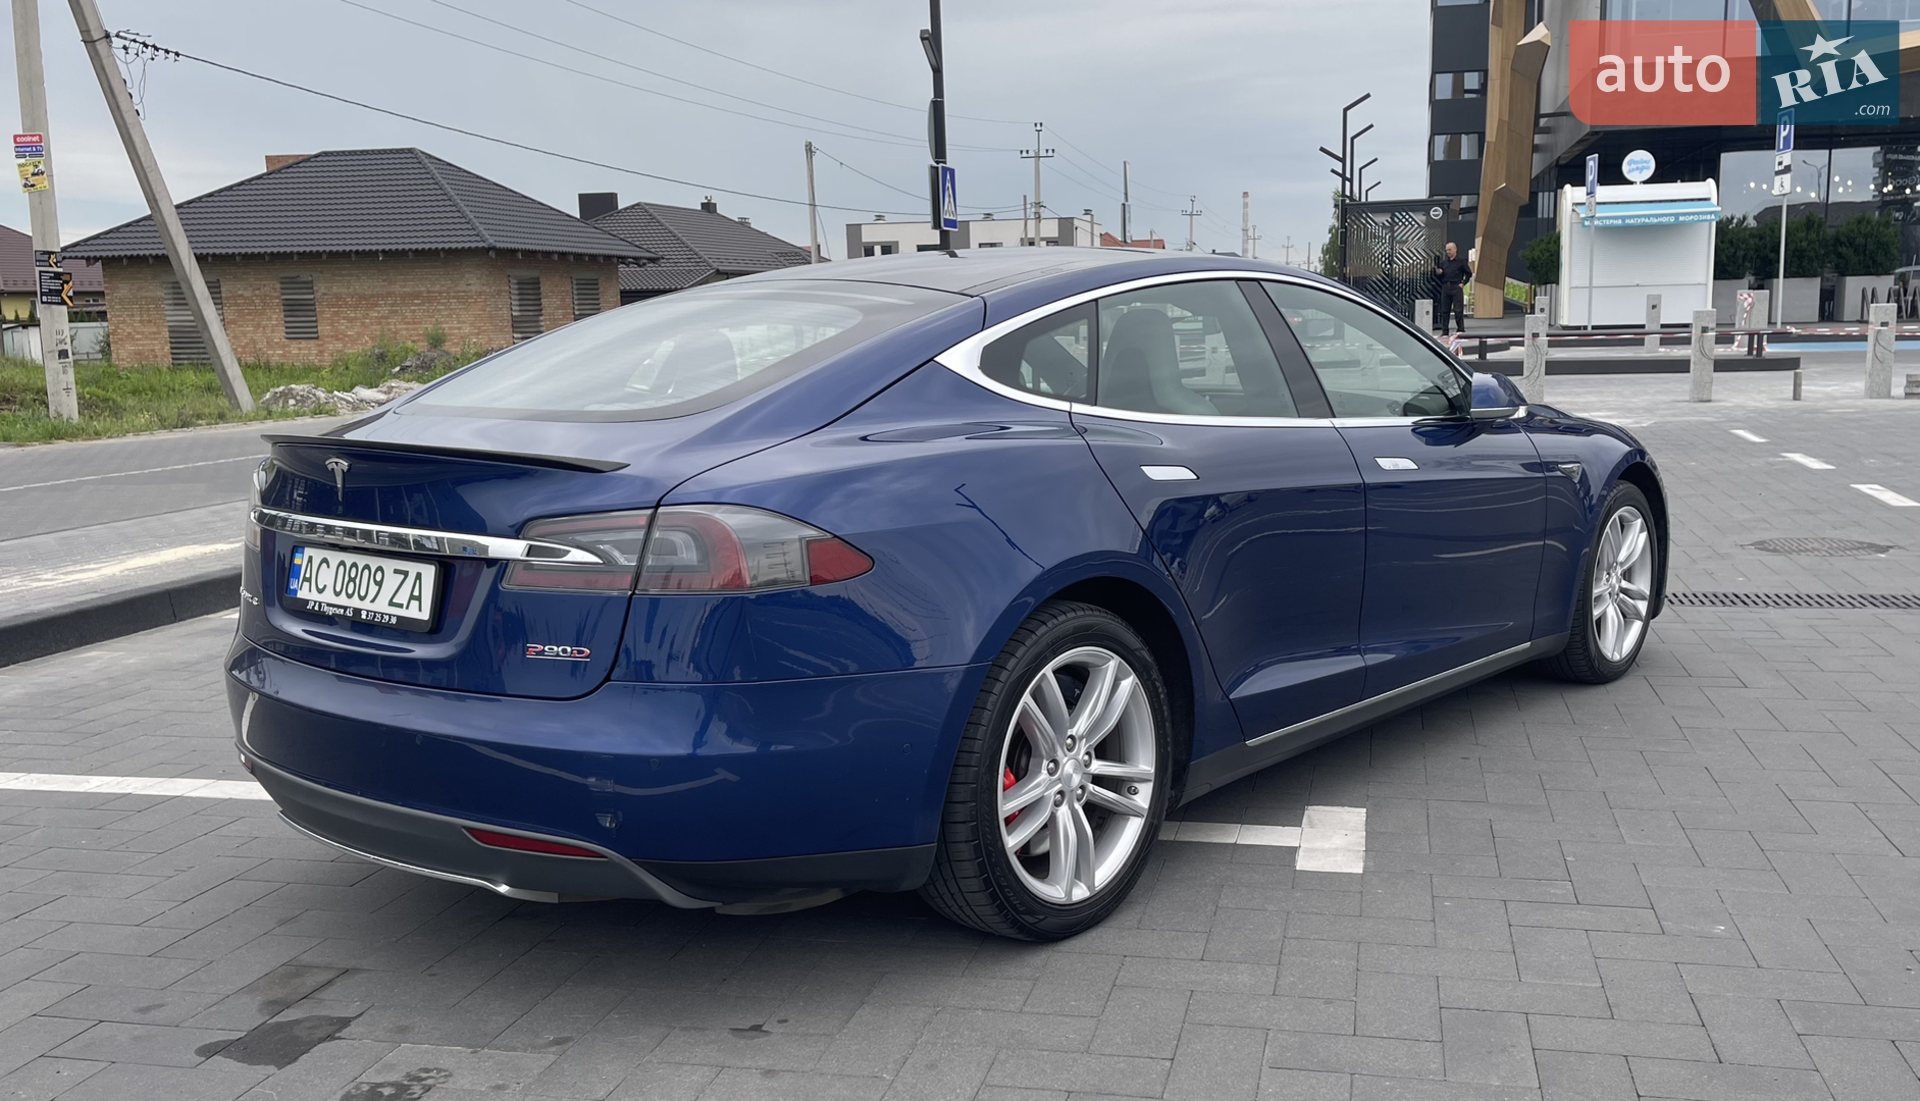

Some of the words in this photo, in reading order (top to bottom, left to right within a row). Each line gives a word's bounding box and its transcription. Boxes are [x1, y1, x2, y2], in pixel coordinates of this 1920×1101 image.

[16, 135, 40, 143] coolnet
[1584, 217, 1622, 226] МЙСТЕРНЯ
[1625, 216, 1675, 224] НАТУРАЛЬНОГО
[1678, 213, 1716, 222] МОРОЗИВА
[289, 578, 299, 590] UA
[299, 555, 330, 595] AC
[333, 559, 385, 604] 0809
[387, 568, 424, 612] ZA
[306, 600, 315, 610] JP
[320, 602, 344, 616] Thygesen
[344, 607, 354, 617] AS
[367, 611, 375, 621] 37
[374, 613, 382, 622] 25
[389, 615, 398, 625] 30
[526, 643, 590, 658] P90D
